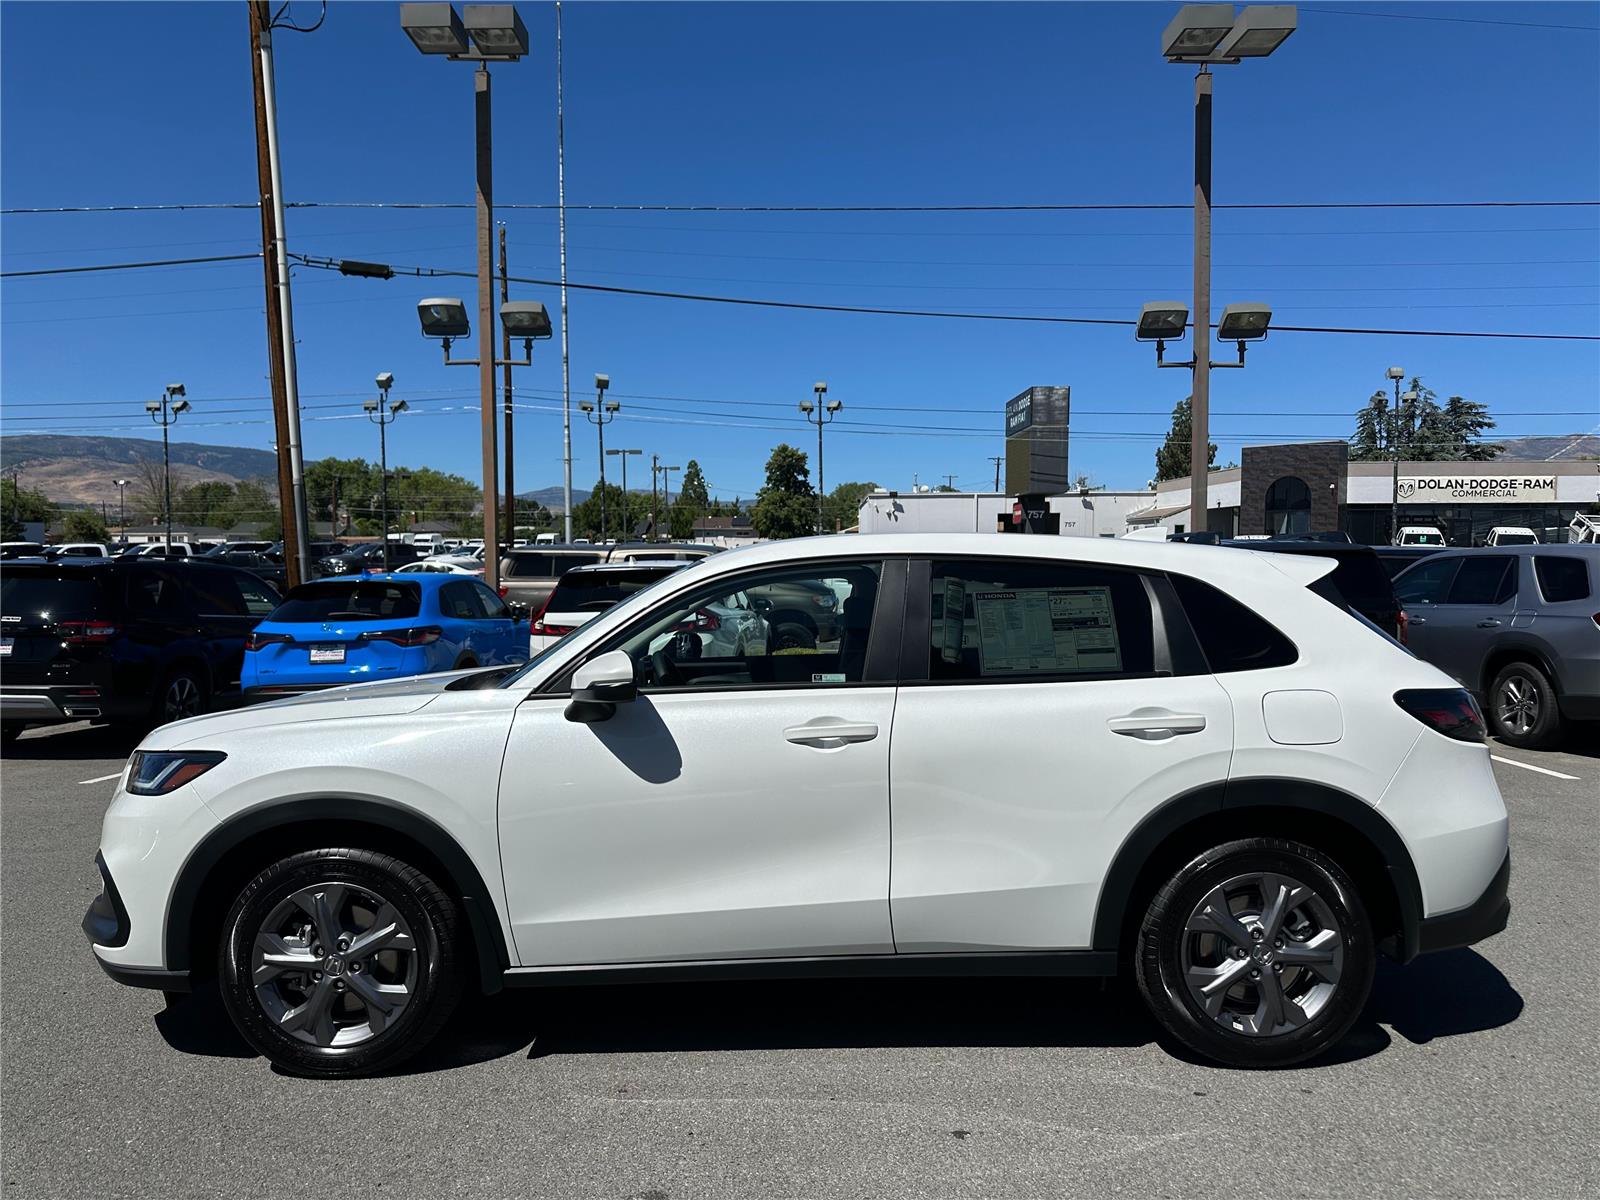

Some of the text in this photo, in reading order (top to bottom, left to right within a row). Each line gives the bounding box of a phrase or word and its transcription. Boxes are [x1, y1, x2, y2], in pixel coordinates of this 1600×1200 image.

[1417, 479, 1554, 490] DOLAN-DODGE-RAM
[1451, 490, 1518, 498] COMMERCIAL
[1027, 510, 1045, 519] 757
